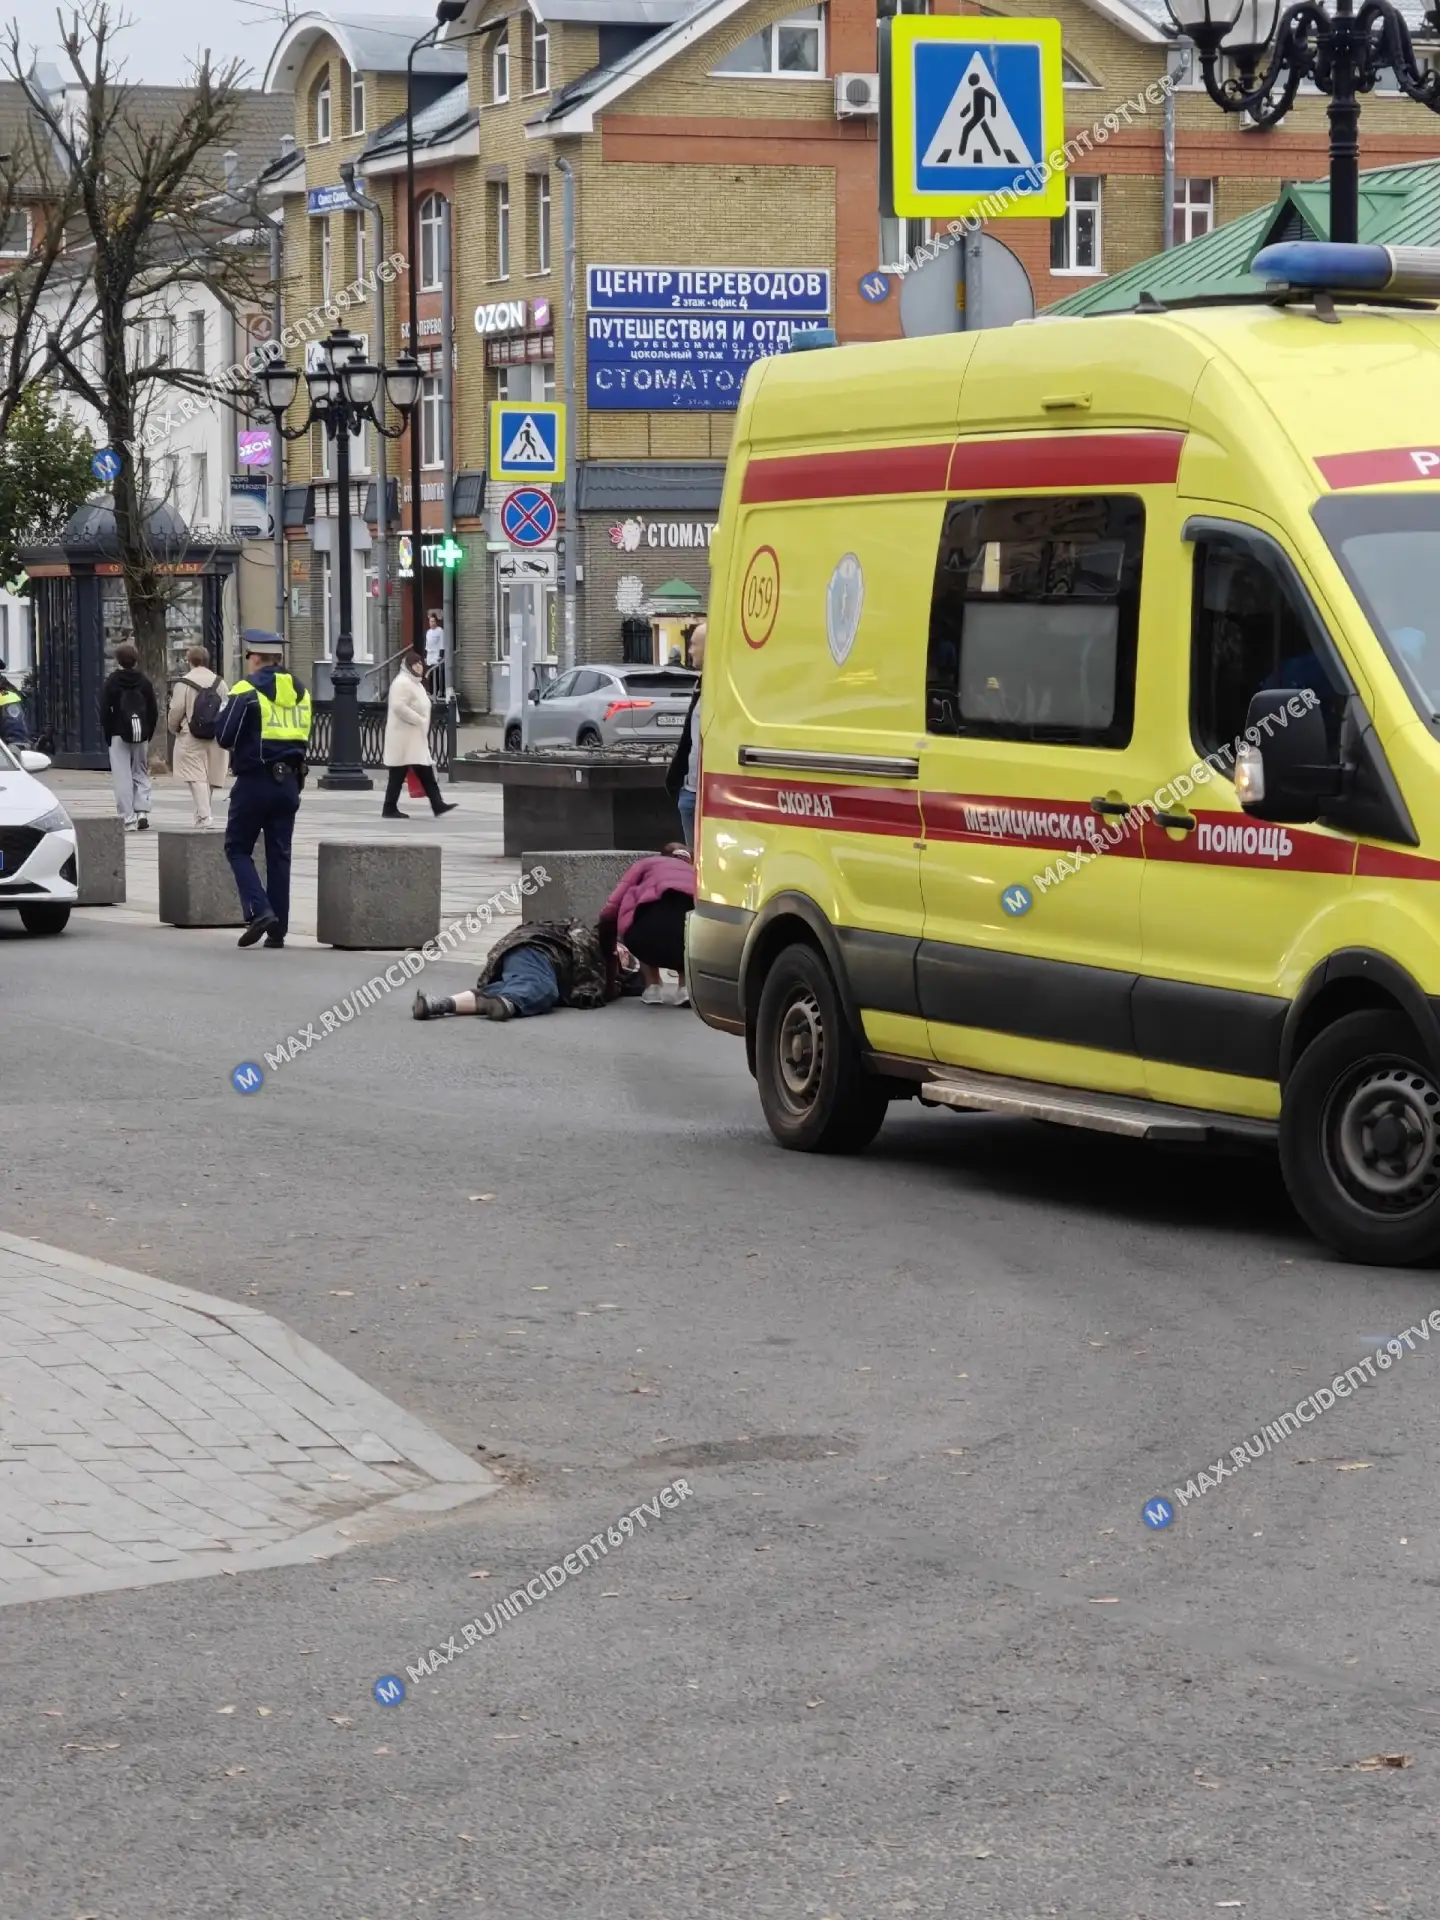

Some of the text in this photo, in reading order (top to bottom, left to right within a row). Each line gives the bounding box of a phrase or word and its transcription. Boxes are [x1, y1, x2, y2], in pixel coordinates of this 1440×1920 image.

[596, 271, 821, 299] ЦЕНТР ПЕРЕВОДОВ
[672, 295, 748, 310] 2 этаж офис 4
[474, 300, 525, 333] OZON
[589, 318, 727, 340] ПУТЕШЕСТВИЯ
[733, 321, 745, 340] И
[608, 340, 624, 348] ЗА
[722, 341, 738, 350] ПО
[631, 350, 692, 359] ЦОКОЛЬНЫЙ
[697, 351, 723, 360] ЭТАЖ
[648, 523, 714, 547] СТОМАТ
[748, 575, 772, 619] 059
[267, 704, 308, 728] ДПС
[778, 791, 1292, 861] СКОРАЯ МЕДИЦИНСКАЯ ПОМОЩЬ
